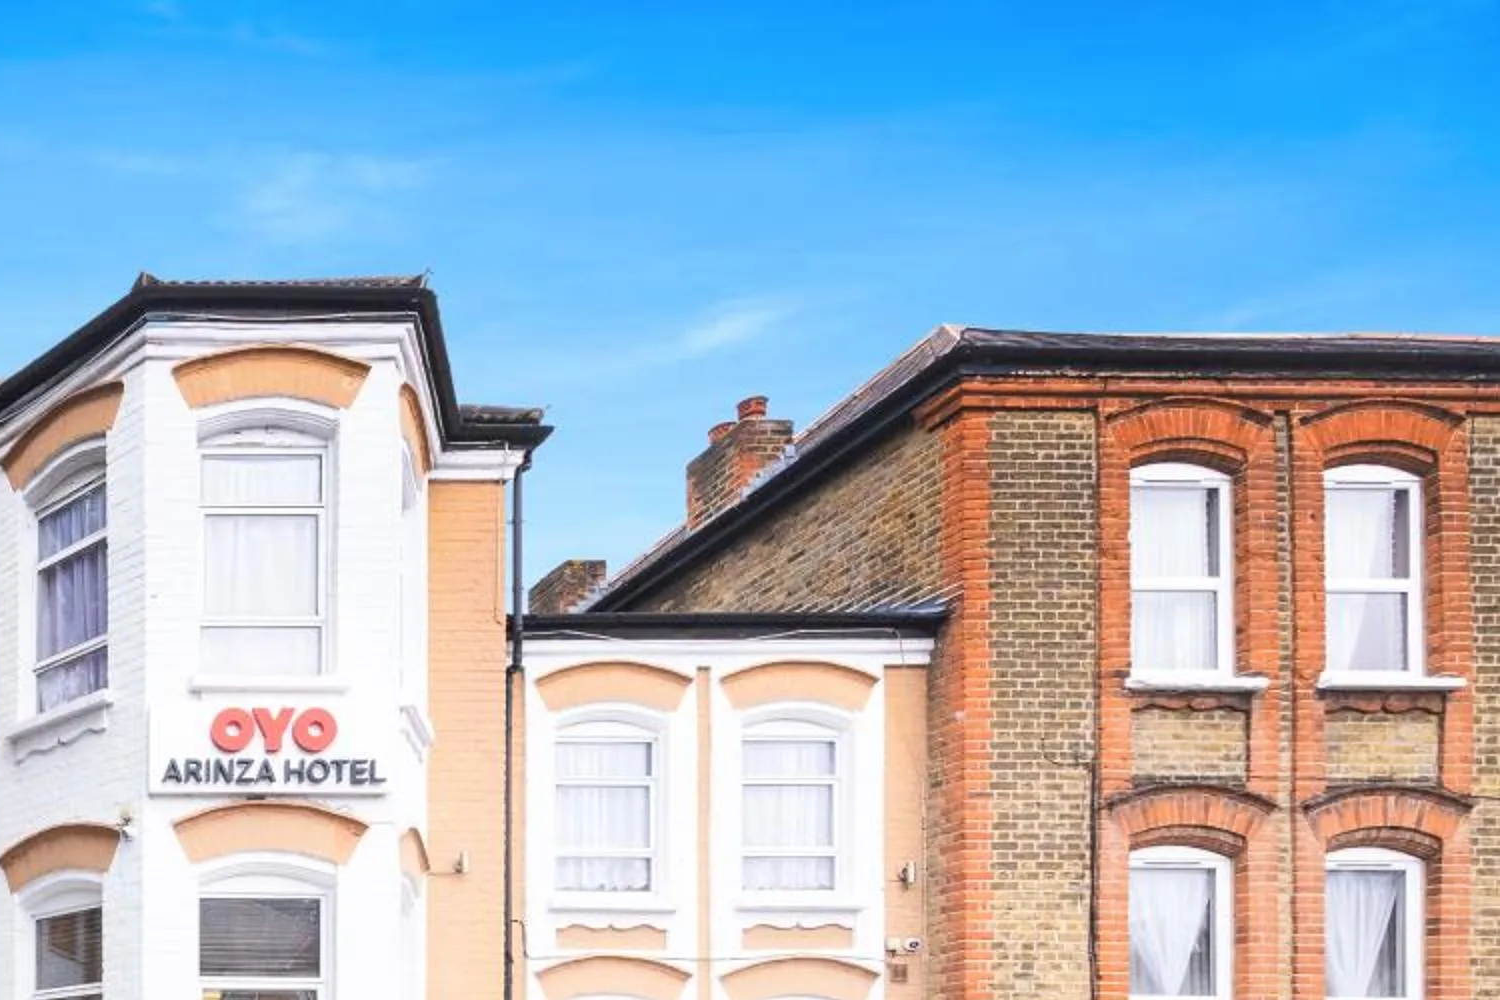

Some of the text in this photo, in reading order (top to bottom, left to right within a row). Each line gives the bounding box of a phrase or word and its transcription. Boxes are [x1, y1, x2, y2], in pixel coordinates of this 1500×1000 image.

[210, 707, 337, 754] OYO
[162, 758, 386, 785] ARINZA HOTEL
